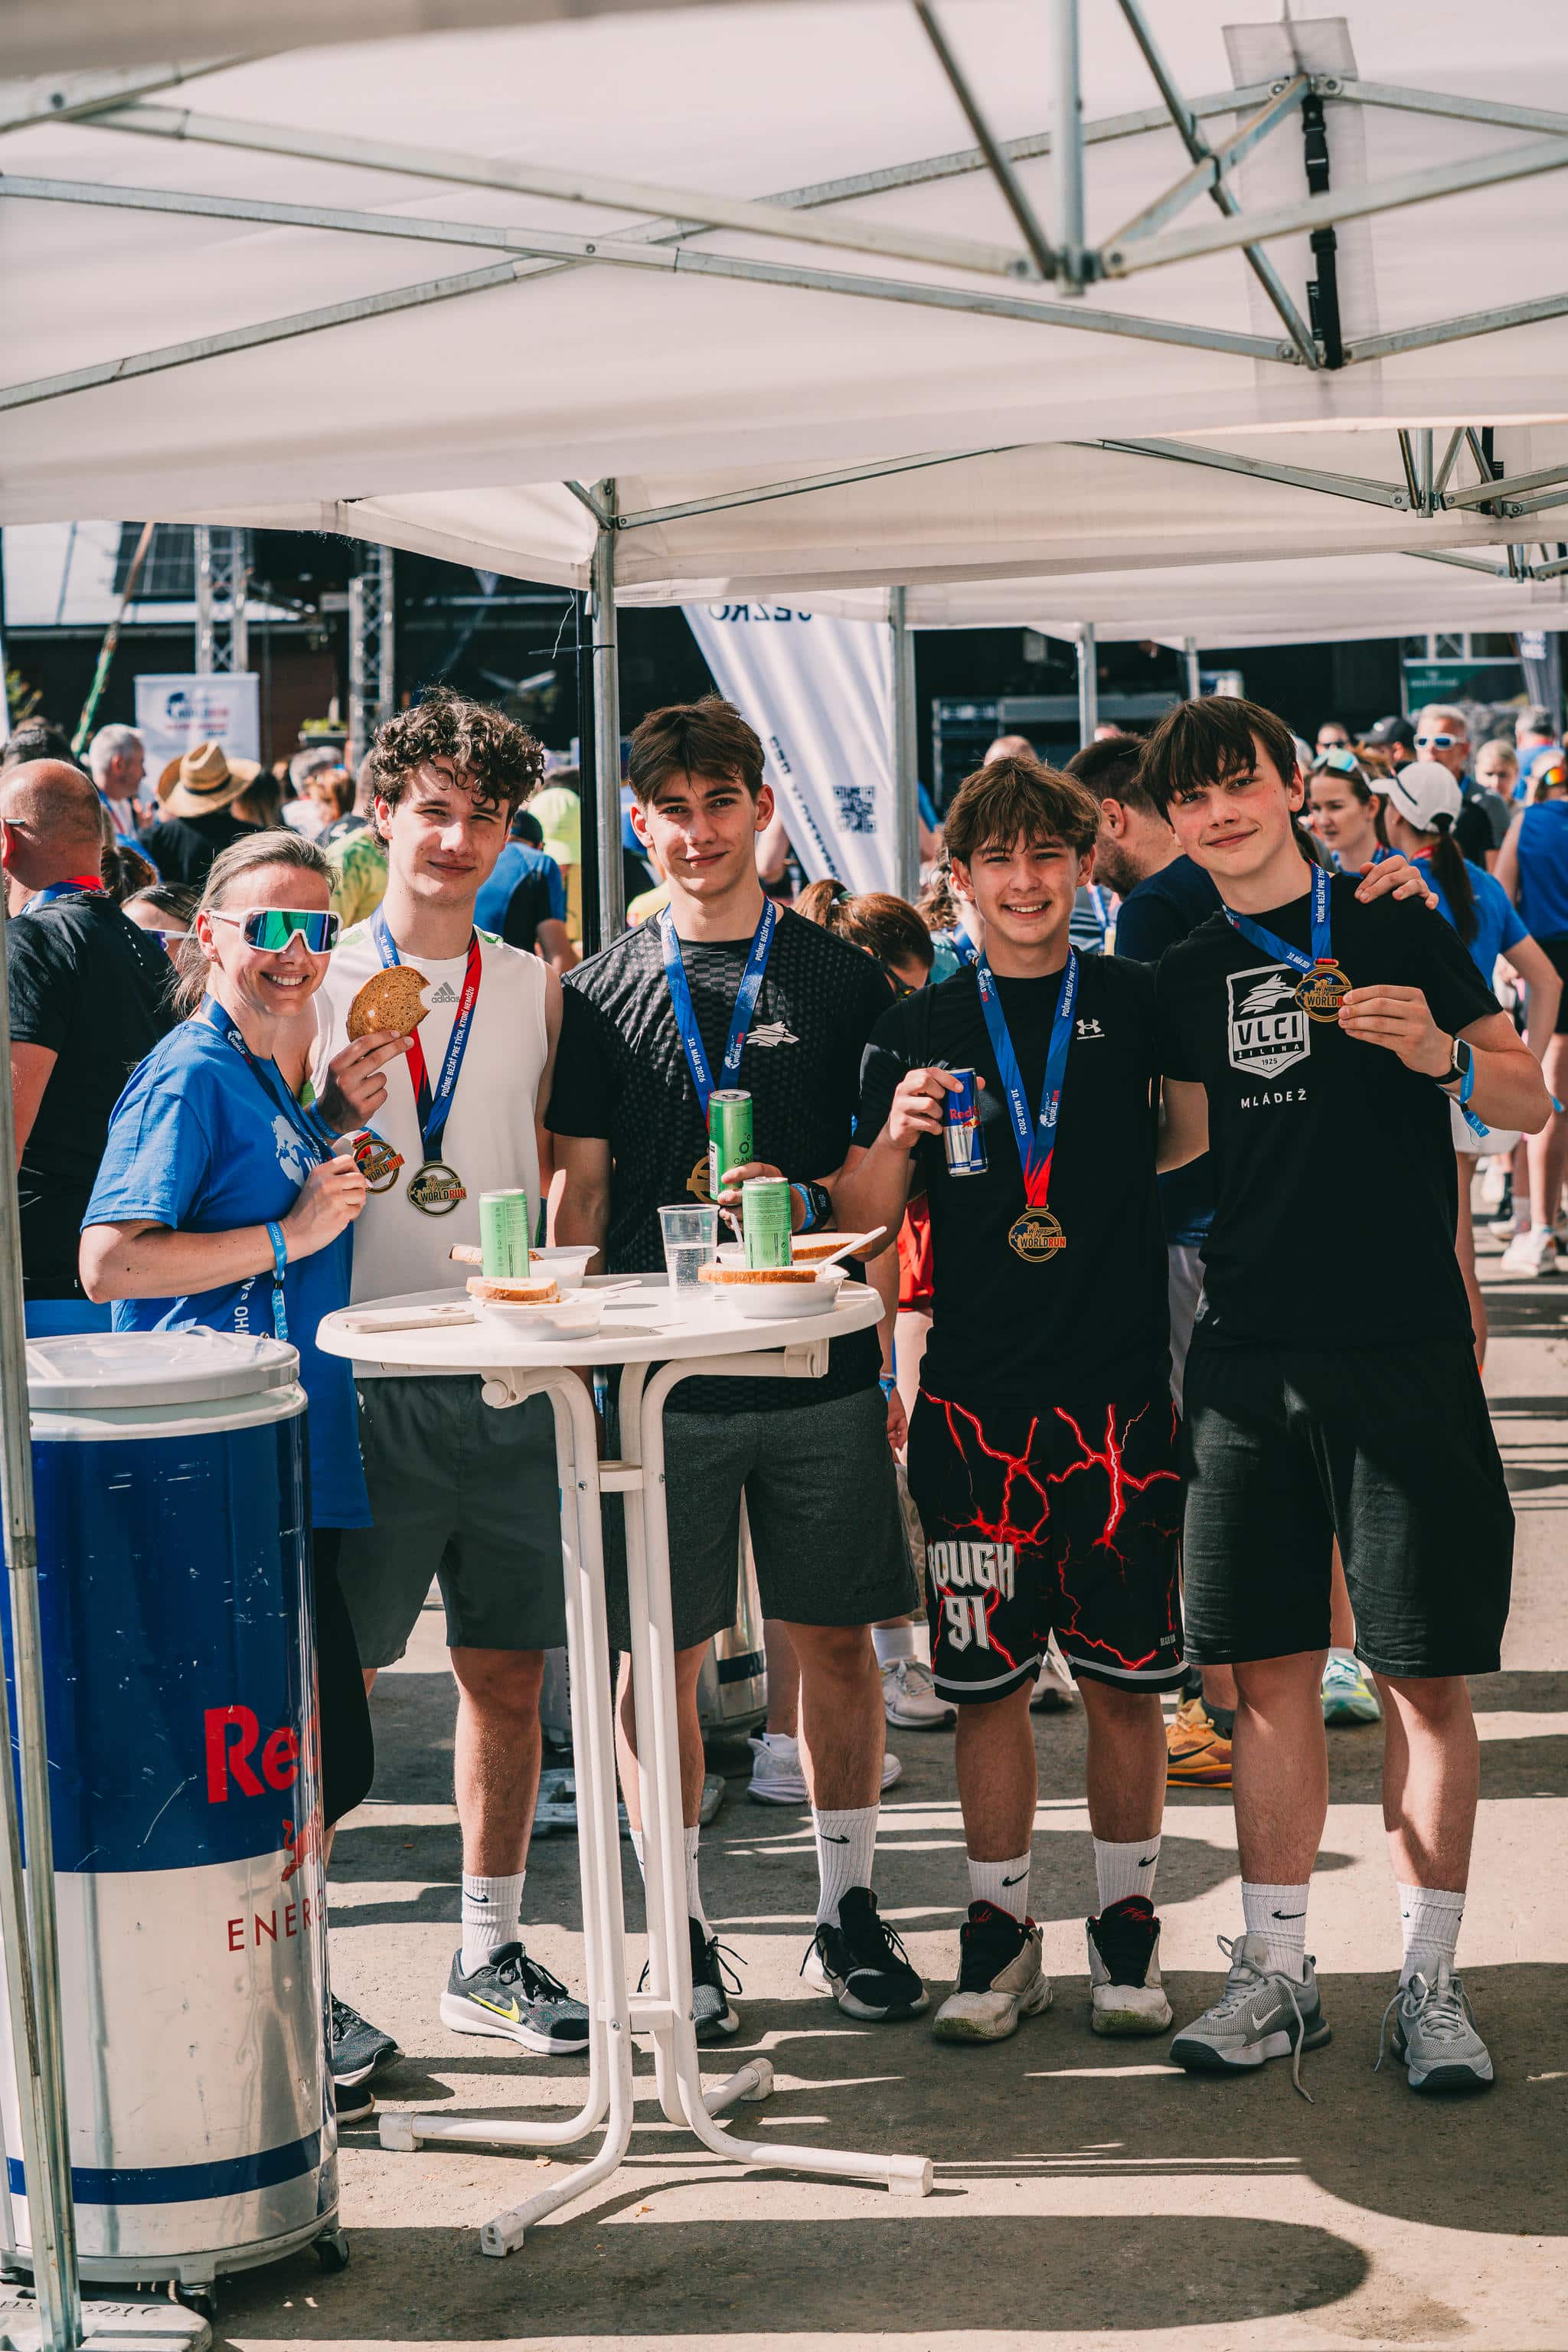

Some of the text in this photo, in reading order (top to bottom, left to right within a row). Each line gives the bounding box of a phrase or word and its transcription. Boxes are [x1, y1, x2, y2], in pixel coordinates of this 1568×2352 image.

[1237, 1014, 1299, 1046] VLCI
[451, 1044, 461, 1058] PRE
[688, 1037, 696, 1050] 10.
[695, 1065, 707, 1083] 2026
[1238, 1044, 1300, 1059] ŽILINA
[1011, 1088, 1020, 1100] 10.
[1017, 1117, 1028, 1135] 2026
[1240, 1088, 1307, 1109] MLÁDEŽ
[949, 1106, 972, 1120] Red
[943, 1596, 989, 1651] 91
